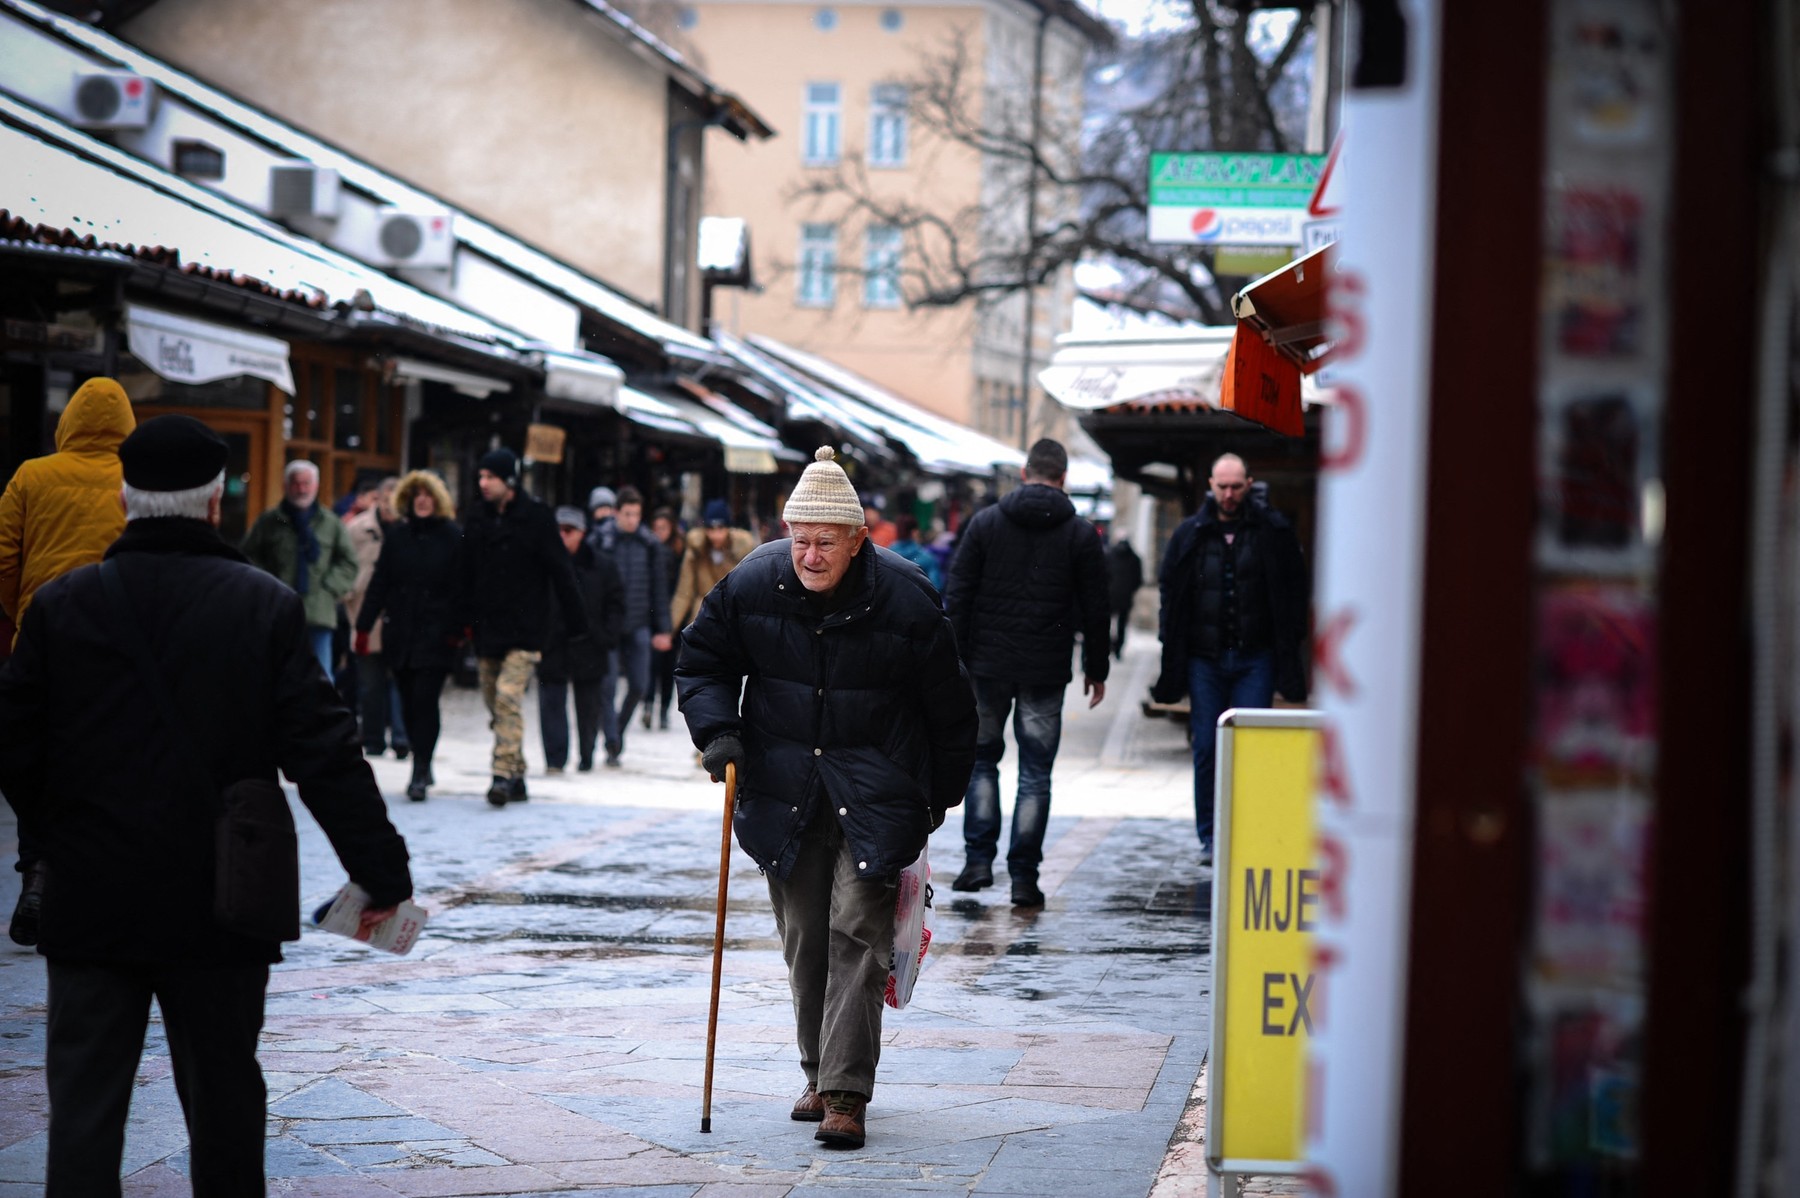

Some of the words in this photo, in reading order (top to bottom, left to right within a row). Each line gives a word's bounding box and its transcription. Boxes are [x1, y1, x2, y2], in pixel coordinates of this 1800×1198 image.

[1226, 215, 1293, 236] pepsi
[1244, 868, 1320, 932] MJE
[1262, 973, 1315, 1037] EX
